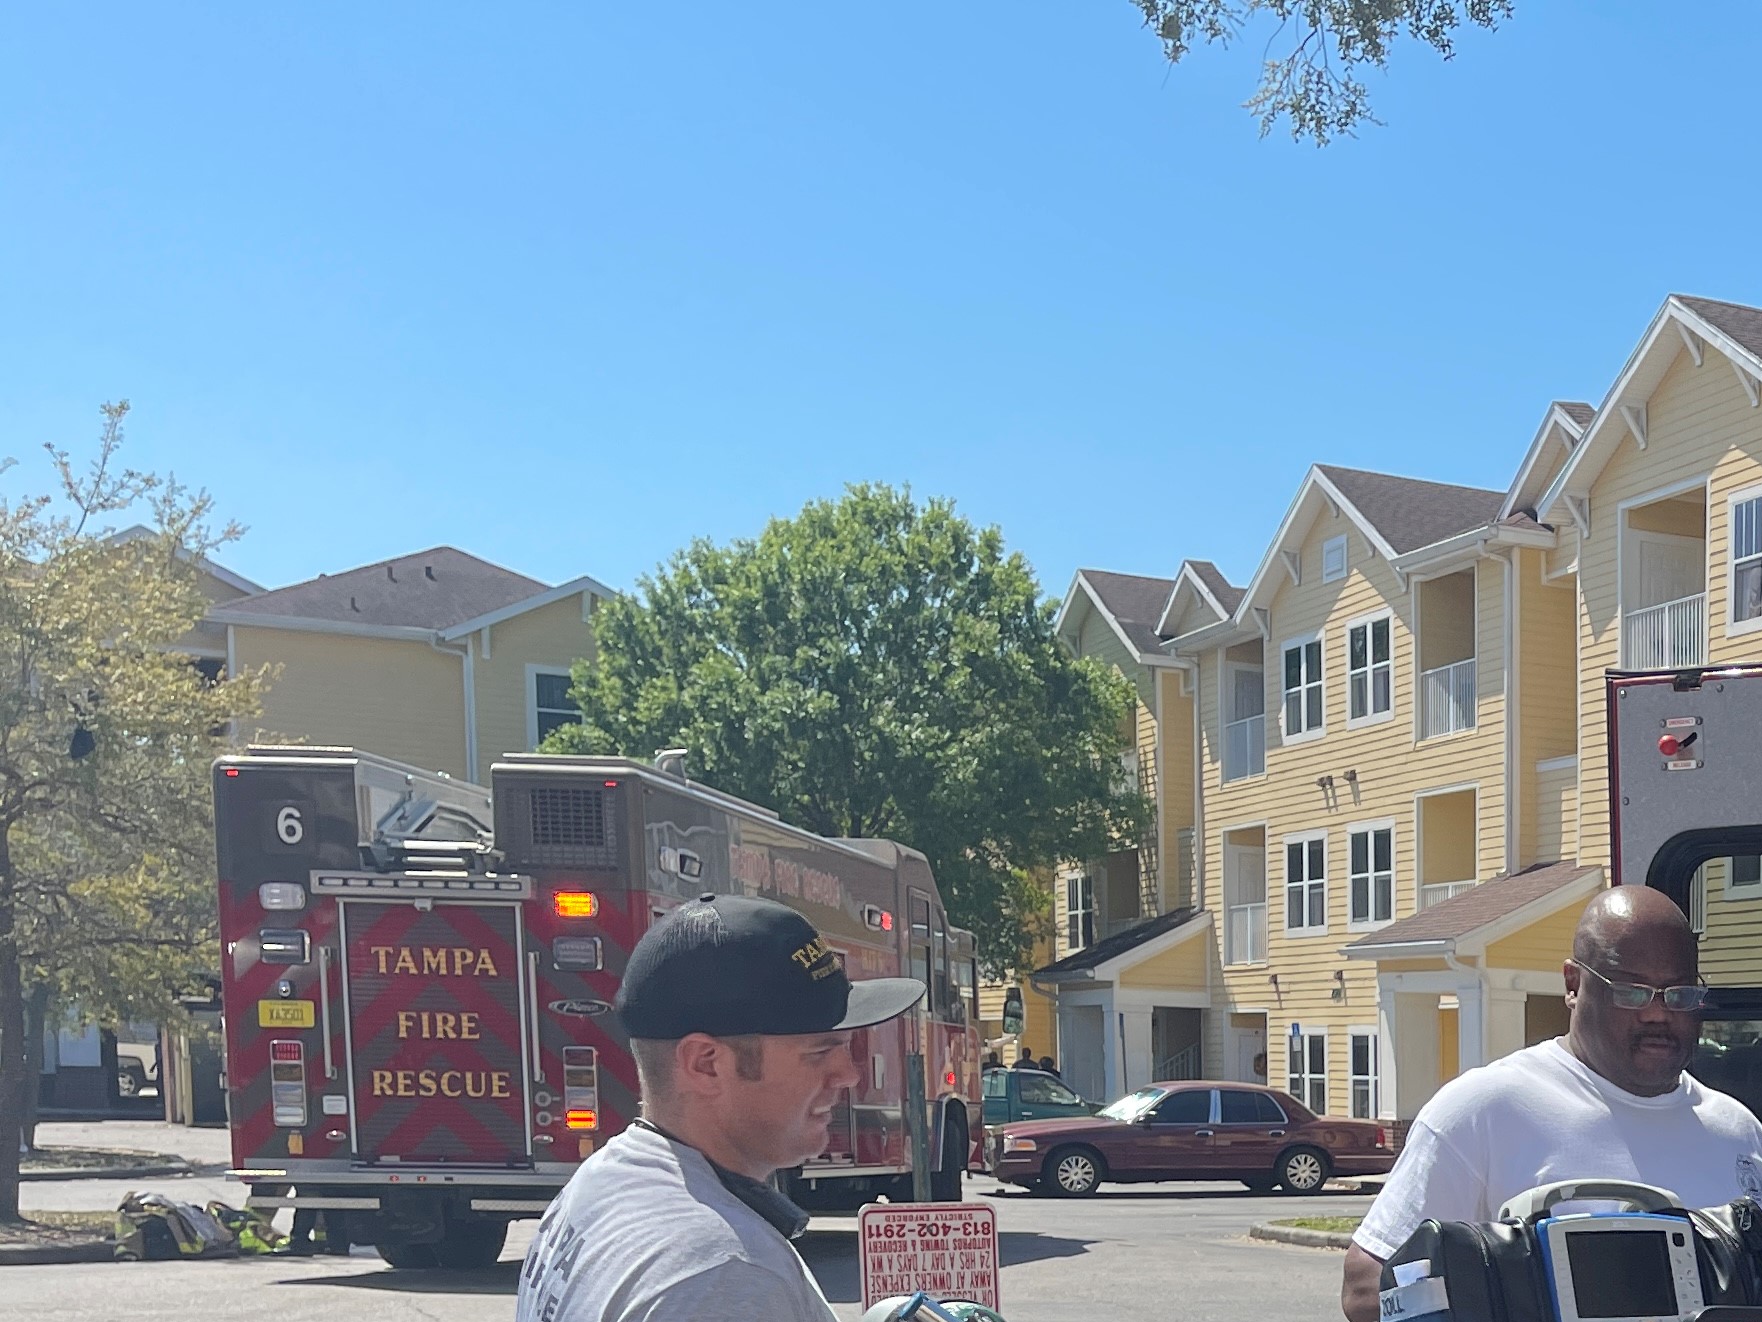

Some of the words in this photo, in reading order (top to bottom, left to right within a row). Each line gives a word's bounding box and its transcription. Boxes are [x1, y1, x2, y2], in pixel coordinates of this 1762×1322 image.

[276, 805, 304, 845] 6
[370, 946, 499, 977] TAMPA
[397, 1011, 481, 1040] FIRE
[371, 1069, 511, 1098] RESCUE
[885, 1214, 930, 1223] ENFORCED
[934, 1213, 973, 1222] STRICTLY
[868, 1221, 991, 1239] 813-402-2911
[868, 1239, 908, 1253] RECOVERY
[910, 1239, 917, 1251] &
[920, 1239, 950, 1251] TOWING
[870, 1255, 884, 1273] WK
[887, 1254, 893, 1272] A
[897, 1253, 918, 1272] DAYS
[921, 1254, 927, 1271] 7
[931, 1253, 946, 1271] DAY
[951, 1253, 956, 1271] A
[960, 1252, 976, 1270] HRS
[980, 1251, 990, 1269] 24
[870, 1273, 911, 1294] EXPENSE
[916, 1271, 952, 1292] OWNERS
[956, 1271, 966, 1291] AT
[969, 1270, 992, 1290] AWAY
